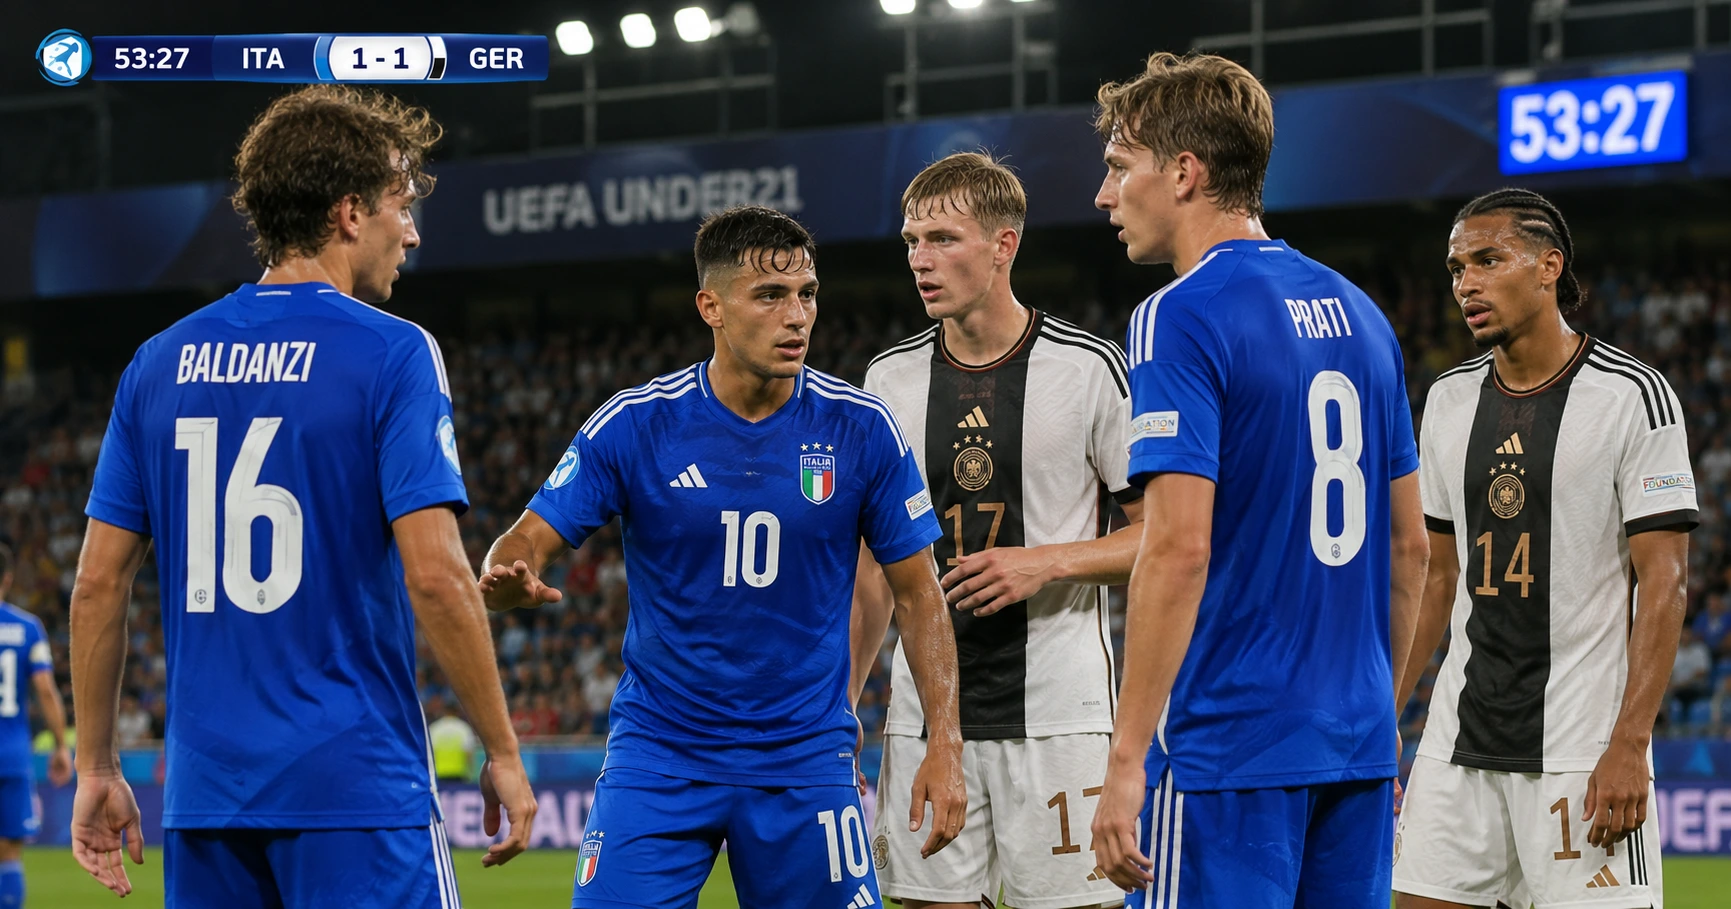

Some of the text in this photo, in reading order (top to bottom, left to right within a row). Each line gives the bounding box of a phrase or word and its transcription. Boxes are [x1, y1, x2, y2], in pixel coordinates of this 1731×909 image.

[1510, 81, 1675, 164] 53:27
[484, 166, 802, 235] UEFA UNDER21
[1284, 297, 1352, 338] PRATI
[176, 341, 316, 384] BALDANZI
[803, 457, 831, 466] ITALIA
[1307, 370, 1367, 567] 8
[175, 416, 303, 614] 16
[720, 510, 781, 588] 10
[944, 502, 1006, 567] 17
[1475, 531, 1535, 598] 14
[817, 804, 870, 883] 10
[1047, 785, 1103, 855] 1
[1550, 797, 1615, 860] 1
